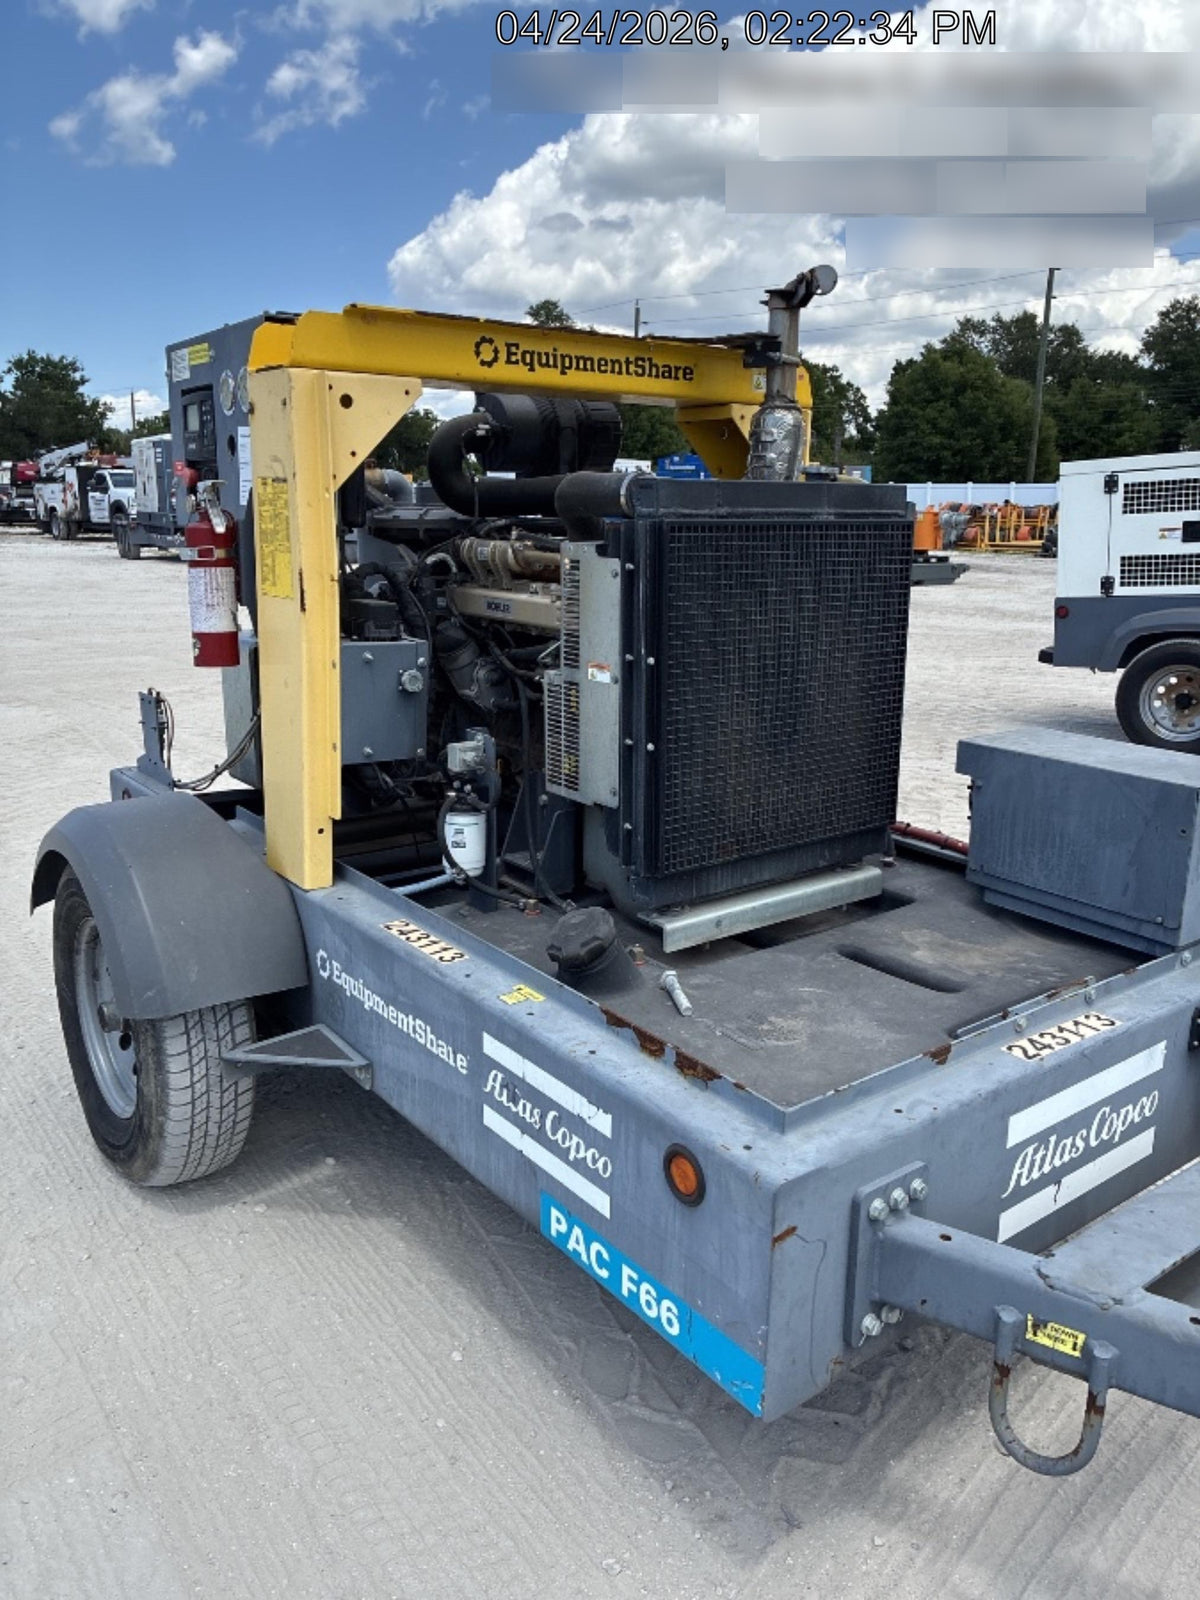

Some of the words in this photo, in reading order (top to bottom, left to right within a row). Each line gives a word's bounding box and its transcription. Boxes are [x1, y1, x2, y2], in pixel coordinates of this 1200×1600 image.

[504, 341, 695, 382] EquipmentShare
[384, 920, 465, 963] 243113
[331, 959, 468, 1075] EquipmentShare
[1006, 1013, 1116, 1060] 243113
[483, 1069, 541, 1130] Atas
[545, 1110, 612, 1178] Copco
[1001, 1128, 1087, 1199] Atlas
[1089, 1089, 1159, 1148] Copco
[550, 1205, 610, 1280] PAC
[621, 1263, 681, 1337] F66
